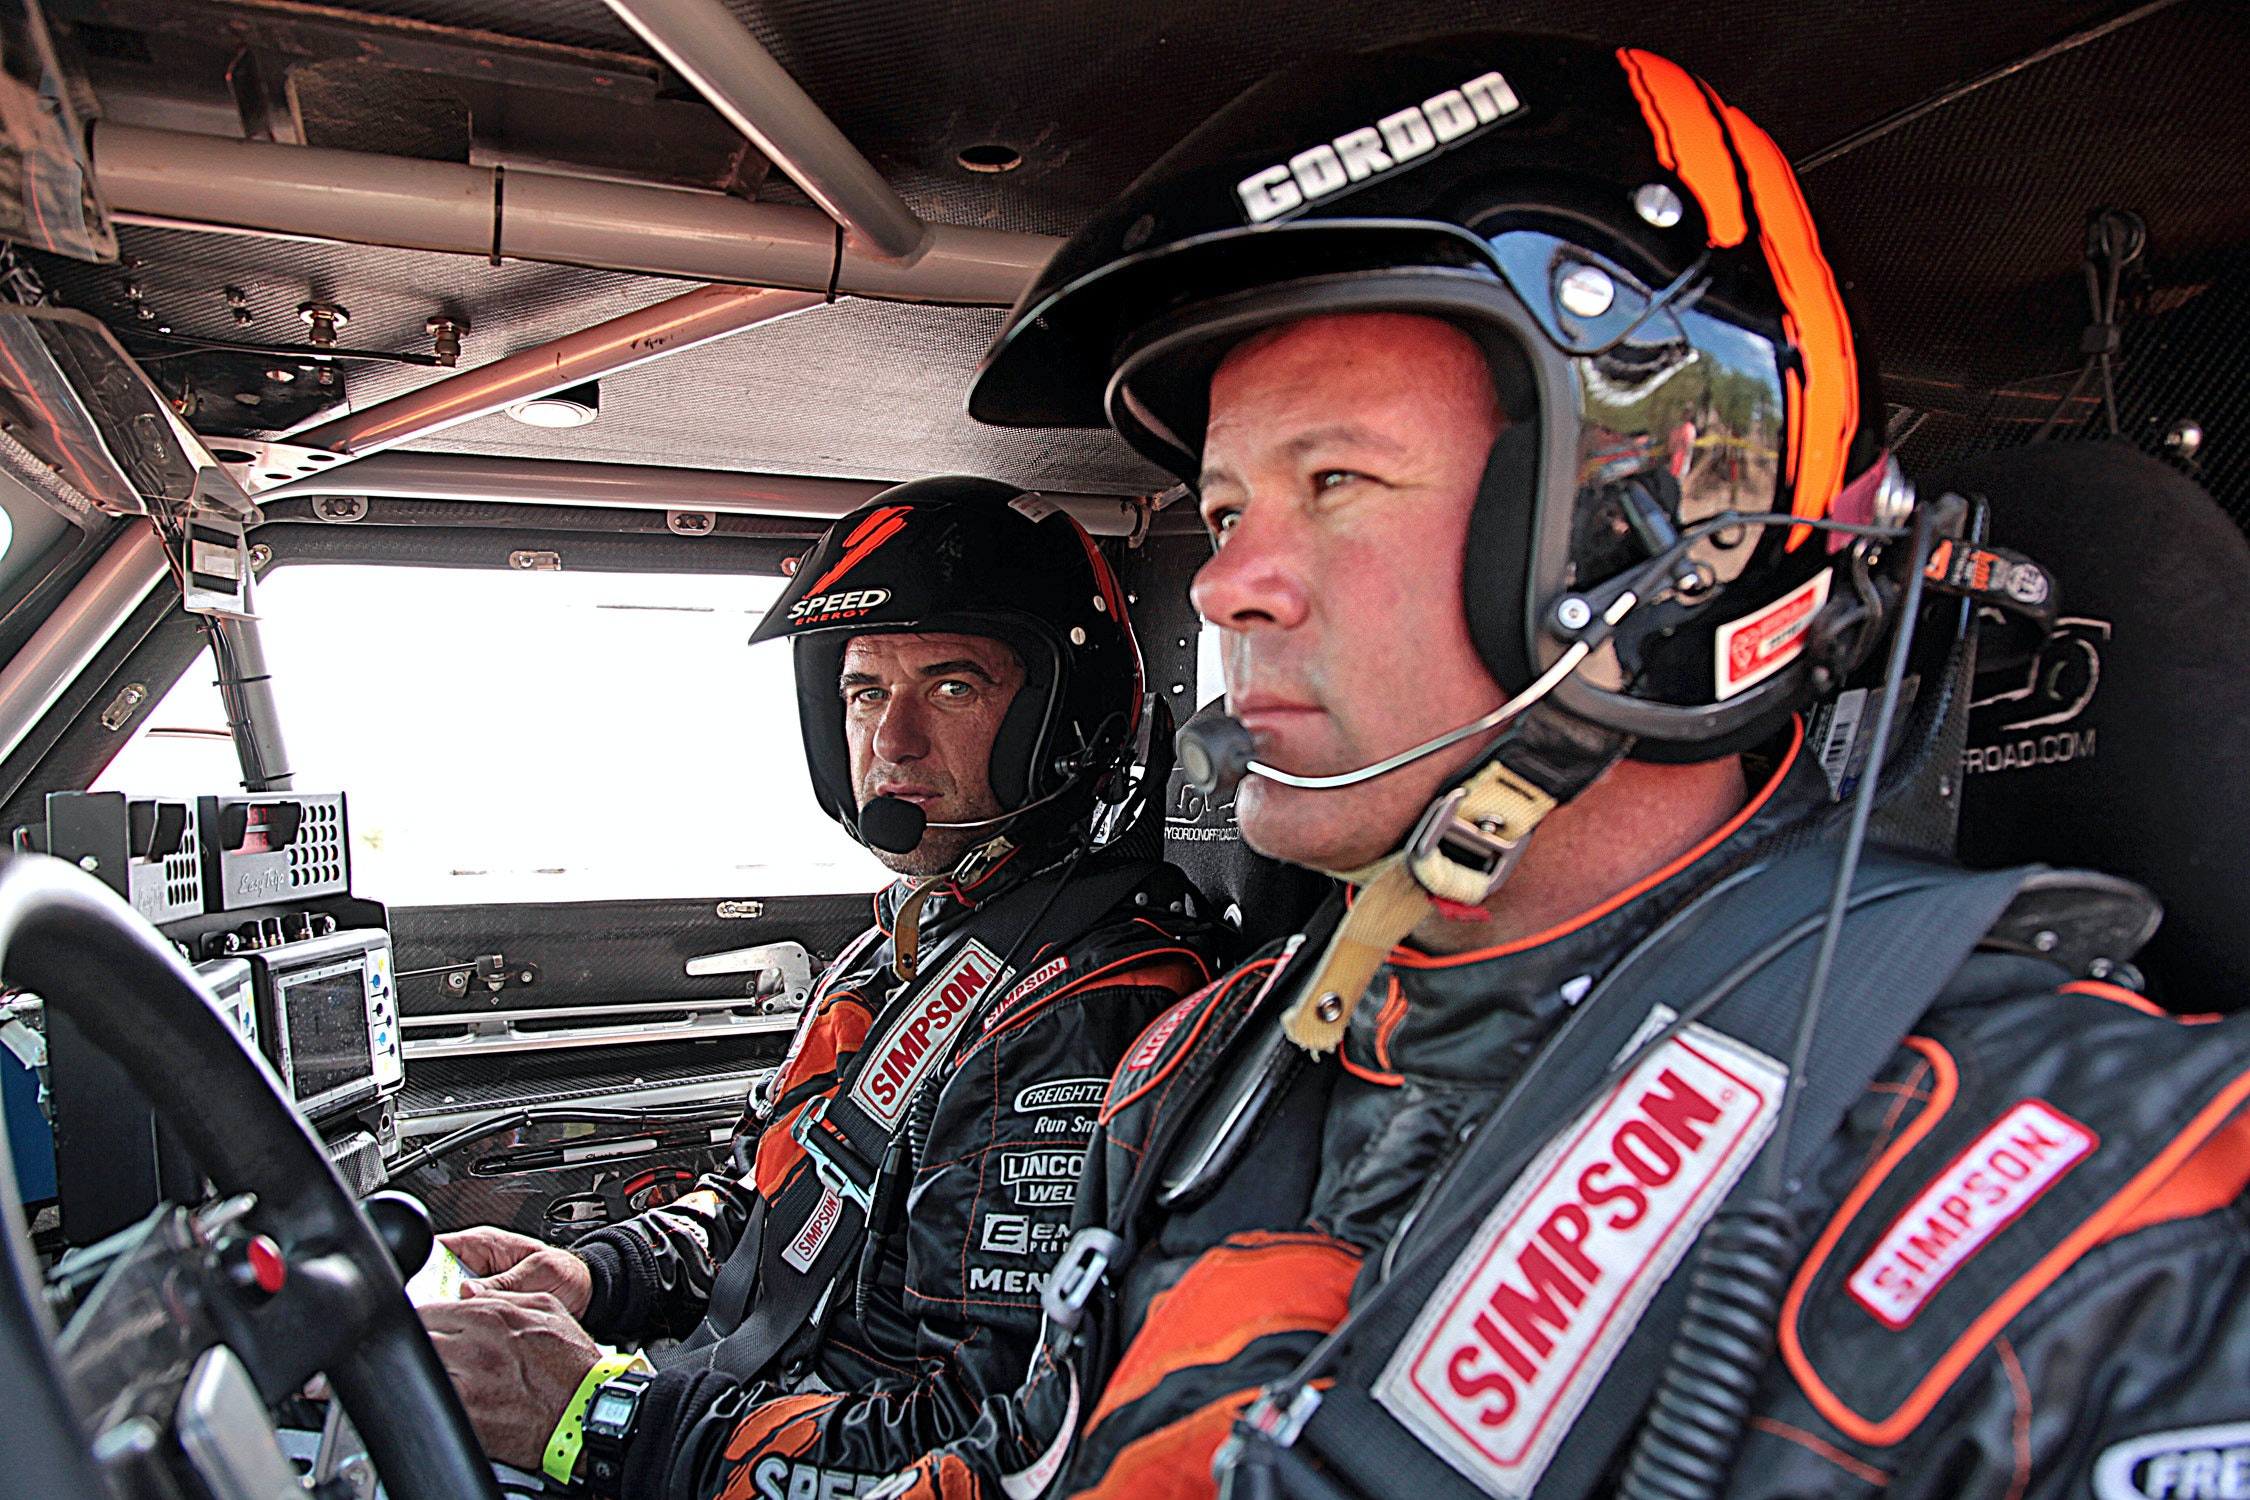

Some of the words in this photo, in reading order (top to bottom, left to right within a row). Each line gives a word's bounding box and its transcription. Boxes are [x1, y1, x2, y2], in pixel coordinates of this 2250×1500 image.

[1236, 70, 1521, 223] GORDON
[786, 588, 888, 620] SPEED
[794, 607, 871, 626] ENERGY
[984, 958, 1067, 1029] SIMPSON
[870, 960, 988, 1107] SIMPSON
[1034, 1115, 1067, 1134] Run
[1008, 1154, 1085, 1179] LINCO
[1029, 1184, 1077, 1202] WEL
[1872, 1122, 2061, 1304] SIMPSON
[798, 1195, 838, 1256] SIMPSON
[1446, 1067, 1722, 1428] SIMPSON
[970, 1266, 1051, 1294] MEN
